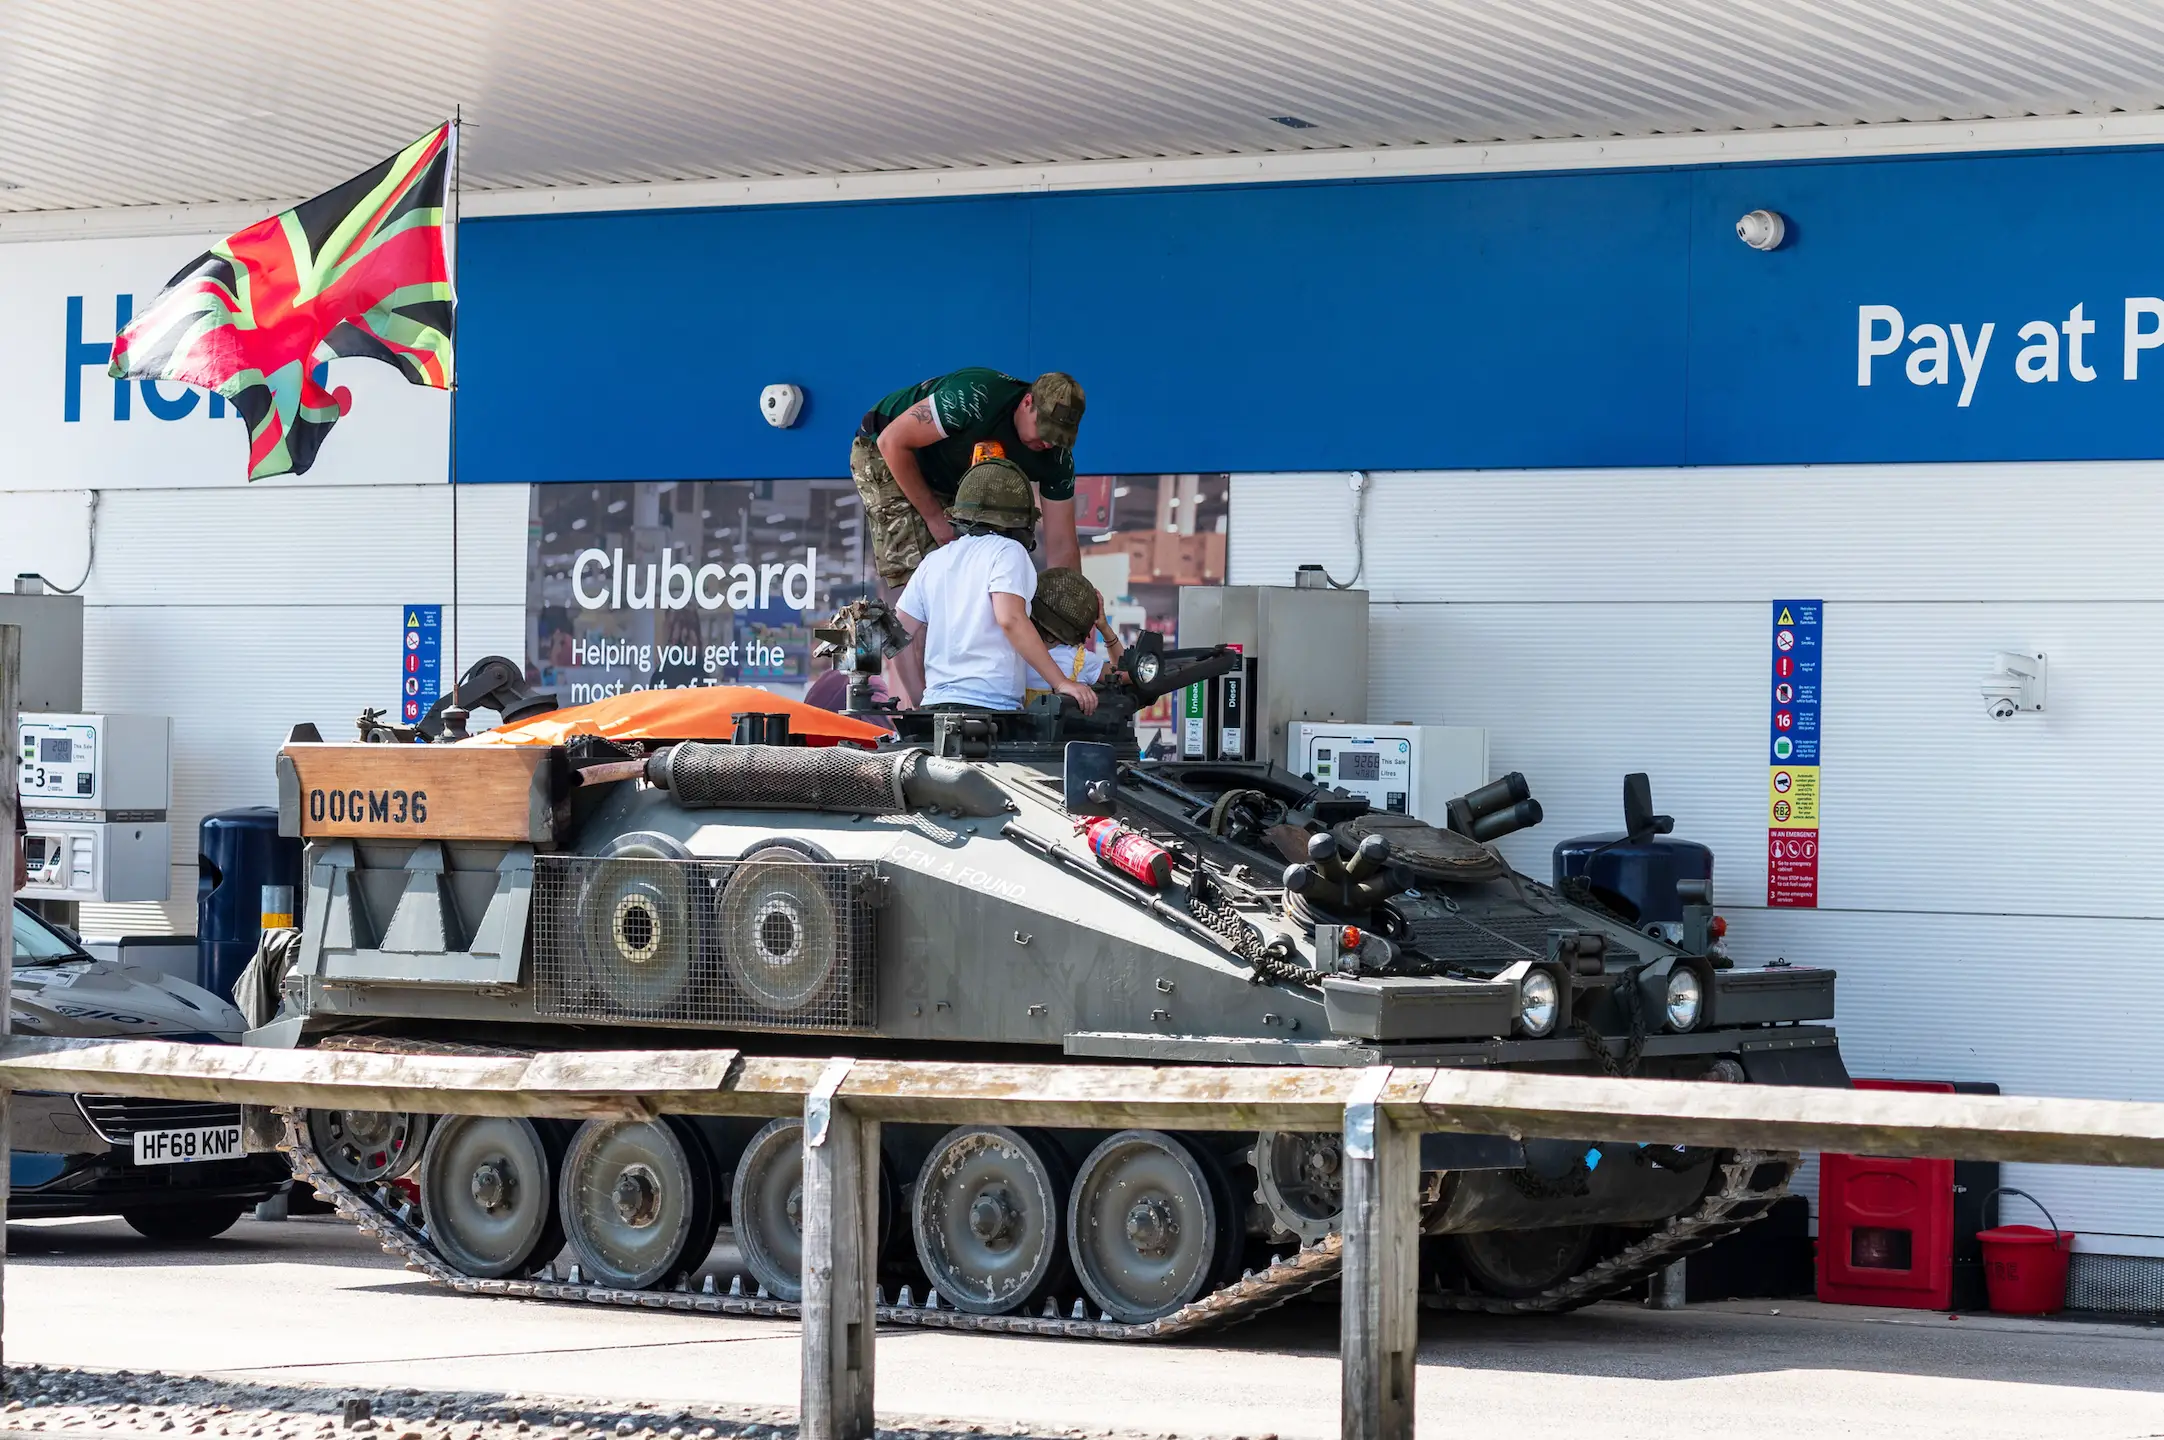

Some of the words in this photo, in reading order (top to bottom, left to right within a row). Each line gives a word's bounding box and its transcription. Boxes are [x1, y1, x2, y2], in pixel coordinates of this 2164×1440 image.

[1857, 304, 1996, 407] Pay
[2014, 301, 2098, 383] at
[2123, 296, 2164, 381] P
[571, 547, 817, 611] Clubcard
[571, 638, 651, 673] Helping
[657, 645, 697, 673] you
[703, 640, 739, 673] get
[745, 639, 785, 667] the
[571, 678, 624, 703] most
[406, 704, 417, 716] 16
[1777, 714, 1790, 727] 16
[36, 768, 45, 787] 3
[891, 846, 936, 869] CFN
[937, 863, 951, 878] A
[956, 865, 1026, 899] FOUND
[143, 1132, 196, 1160] HF68
[201, 1129, 239, 1155] KNP
